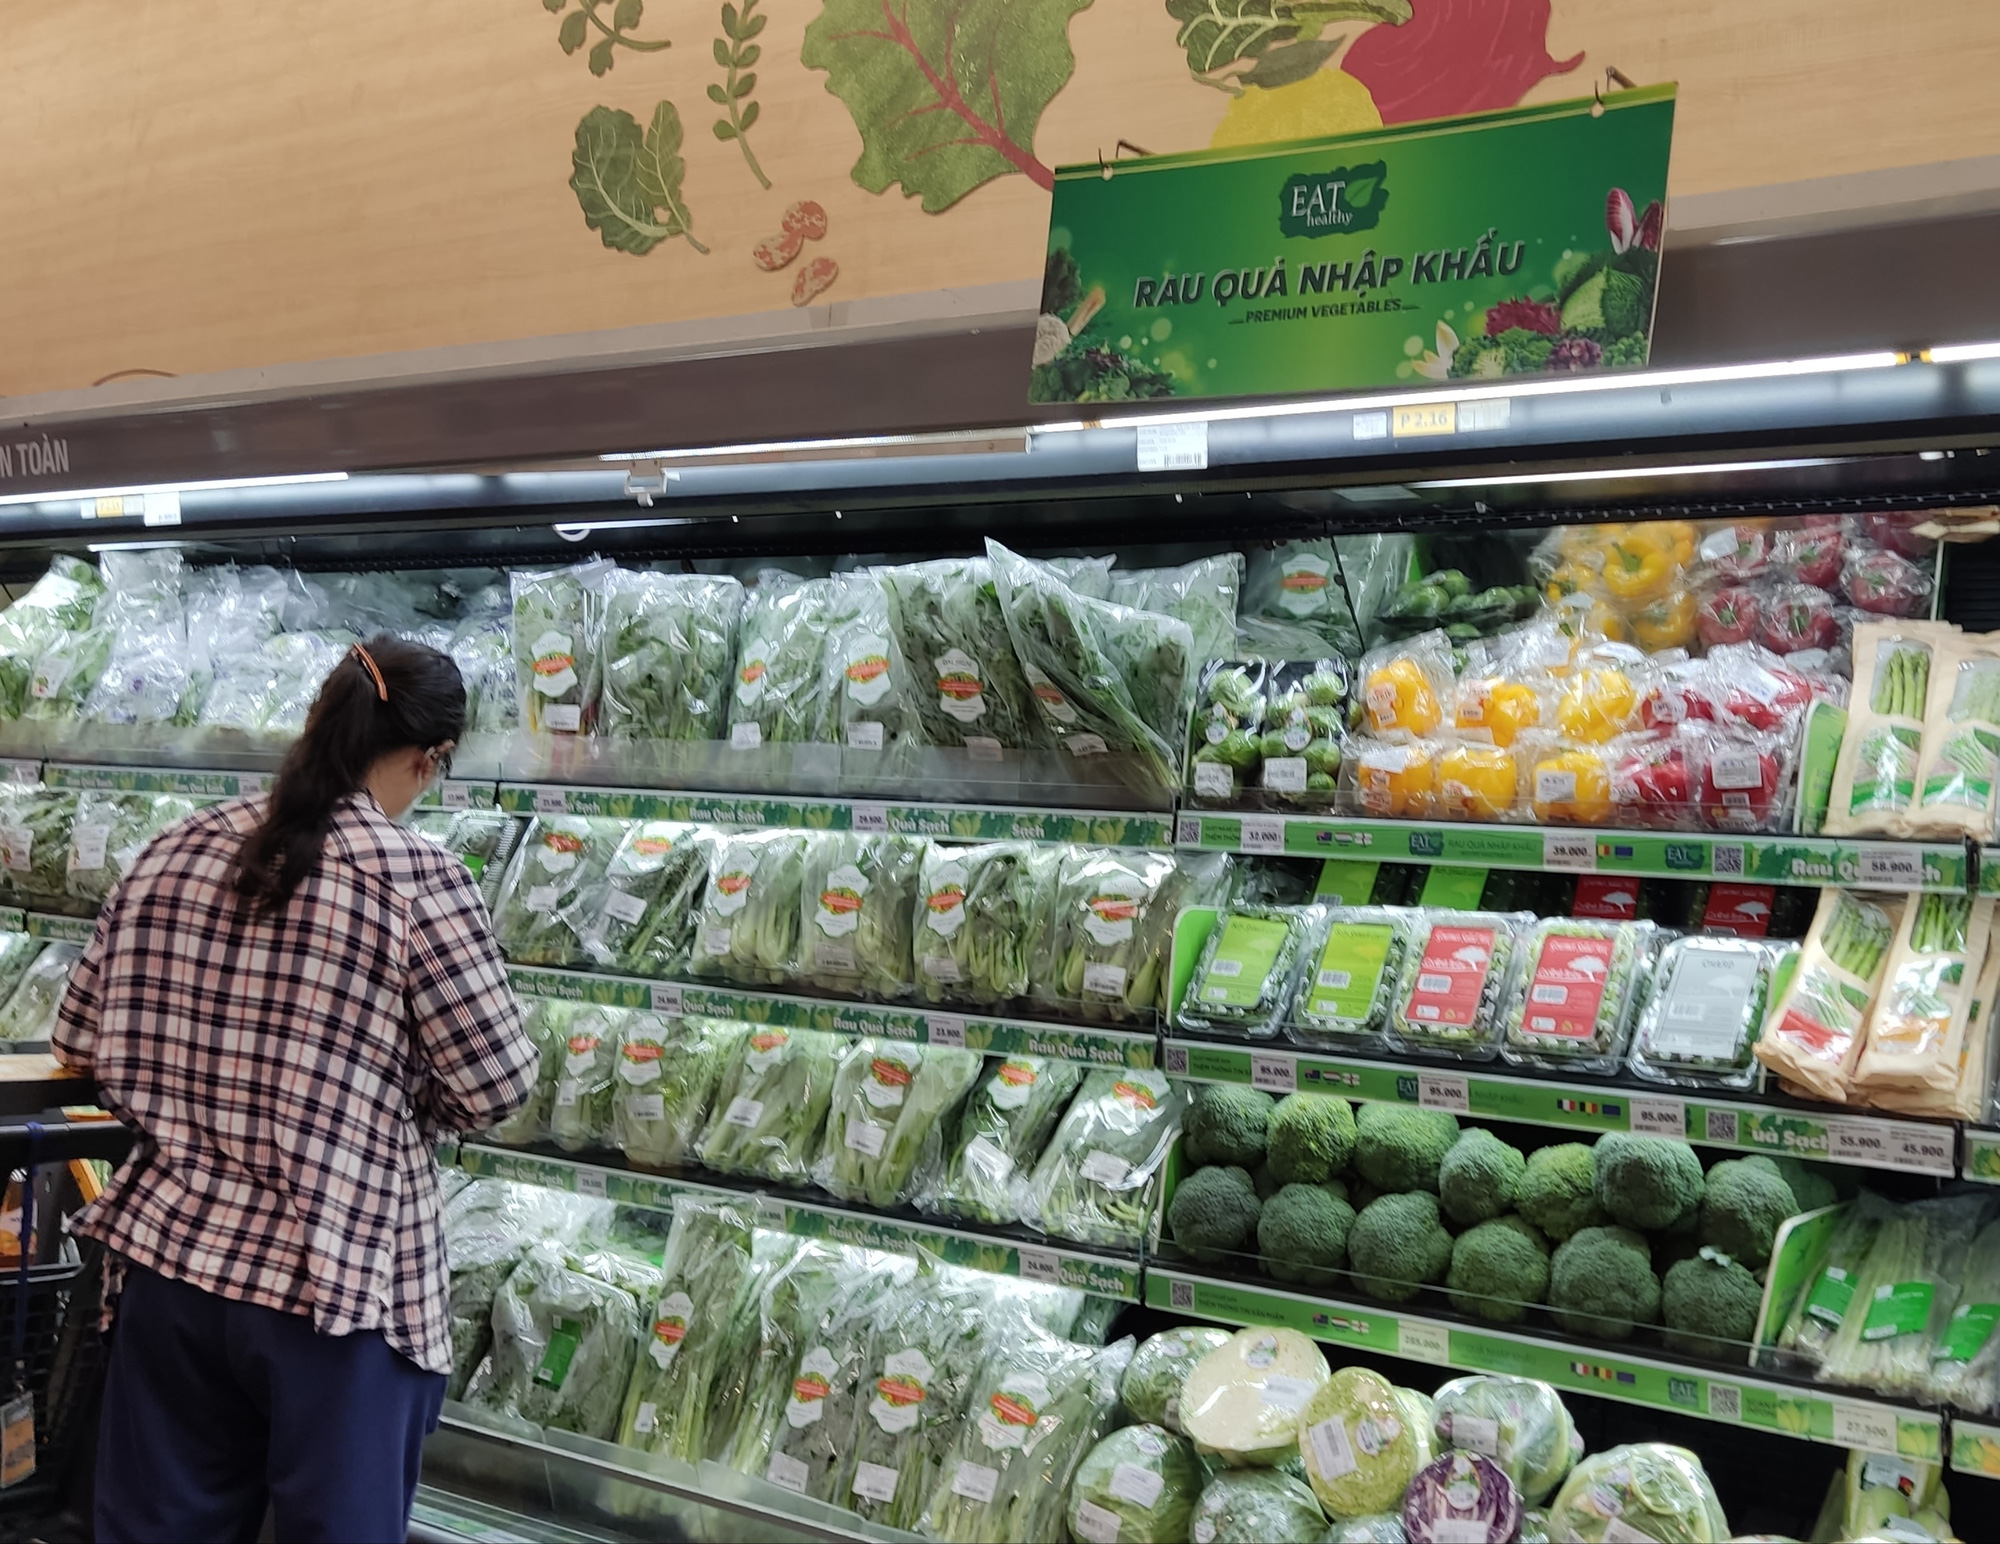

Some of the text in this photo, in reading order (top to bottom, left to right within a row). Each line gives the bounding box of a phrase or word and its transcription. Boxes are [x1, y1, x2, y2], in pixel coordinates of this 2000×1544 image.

[1291, 181, 1345, 218] EAT
[1306, 208, 1354, 228] healthy
[1133, 227, 1526, 308] RAU QUẢ NHẬP KHẨU
[1245, 298, 1403, 324] PREMIUM VEGETABLES
[15, 432, 70, 477] TOÀN
[1411, 834, 1430, 848] EAT
[1667, 847, 1688, 860] EAT
[1791, 858, 1834, 878] Rau
[832, 1016, 857, 1032] Rau
[1028, 1039, 1056, 1055] Rau
[1088, 1045, 1124, 1064] Sạch
[1839, 1134, 1882, 1151] 55.900
